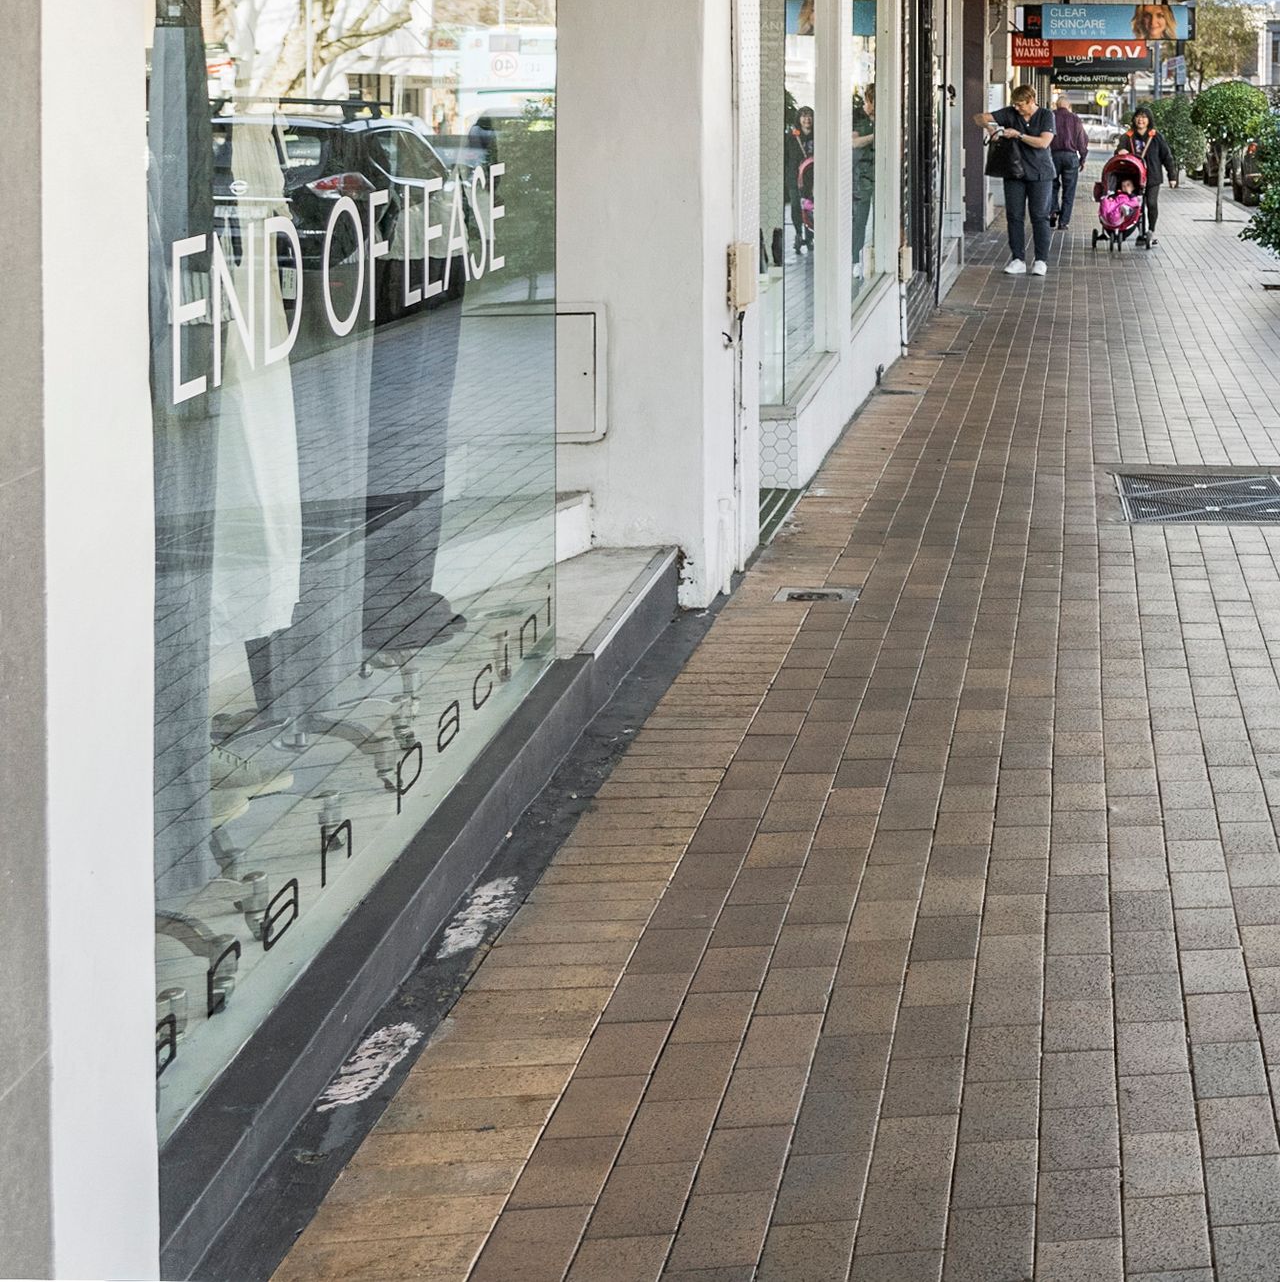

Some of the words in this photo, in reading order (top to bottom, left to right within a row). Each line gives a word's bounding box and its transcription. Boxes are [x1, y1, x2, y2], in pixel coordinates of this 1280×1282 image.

[1050, 7, 1087, 18] CLEAR
[1050, 19, 1106, 29] SKINCARE
[1015, 37, 1041, 47] NAILS
[1014, 47, 1050, 57] WAXING
[172, 216, 303, 405] END
[323, 189, 389, 337] OF
[404, 162, 506, 308] LEASE
[396, 582, 551, 816] pacini
